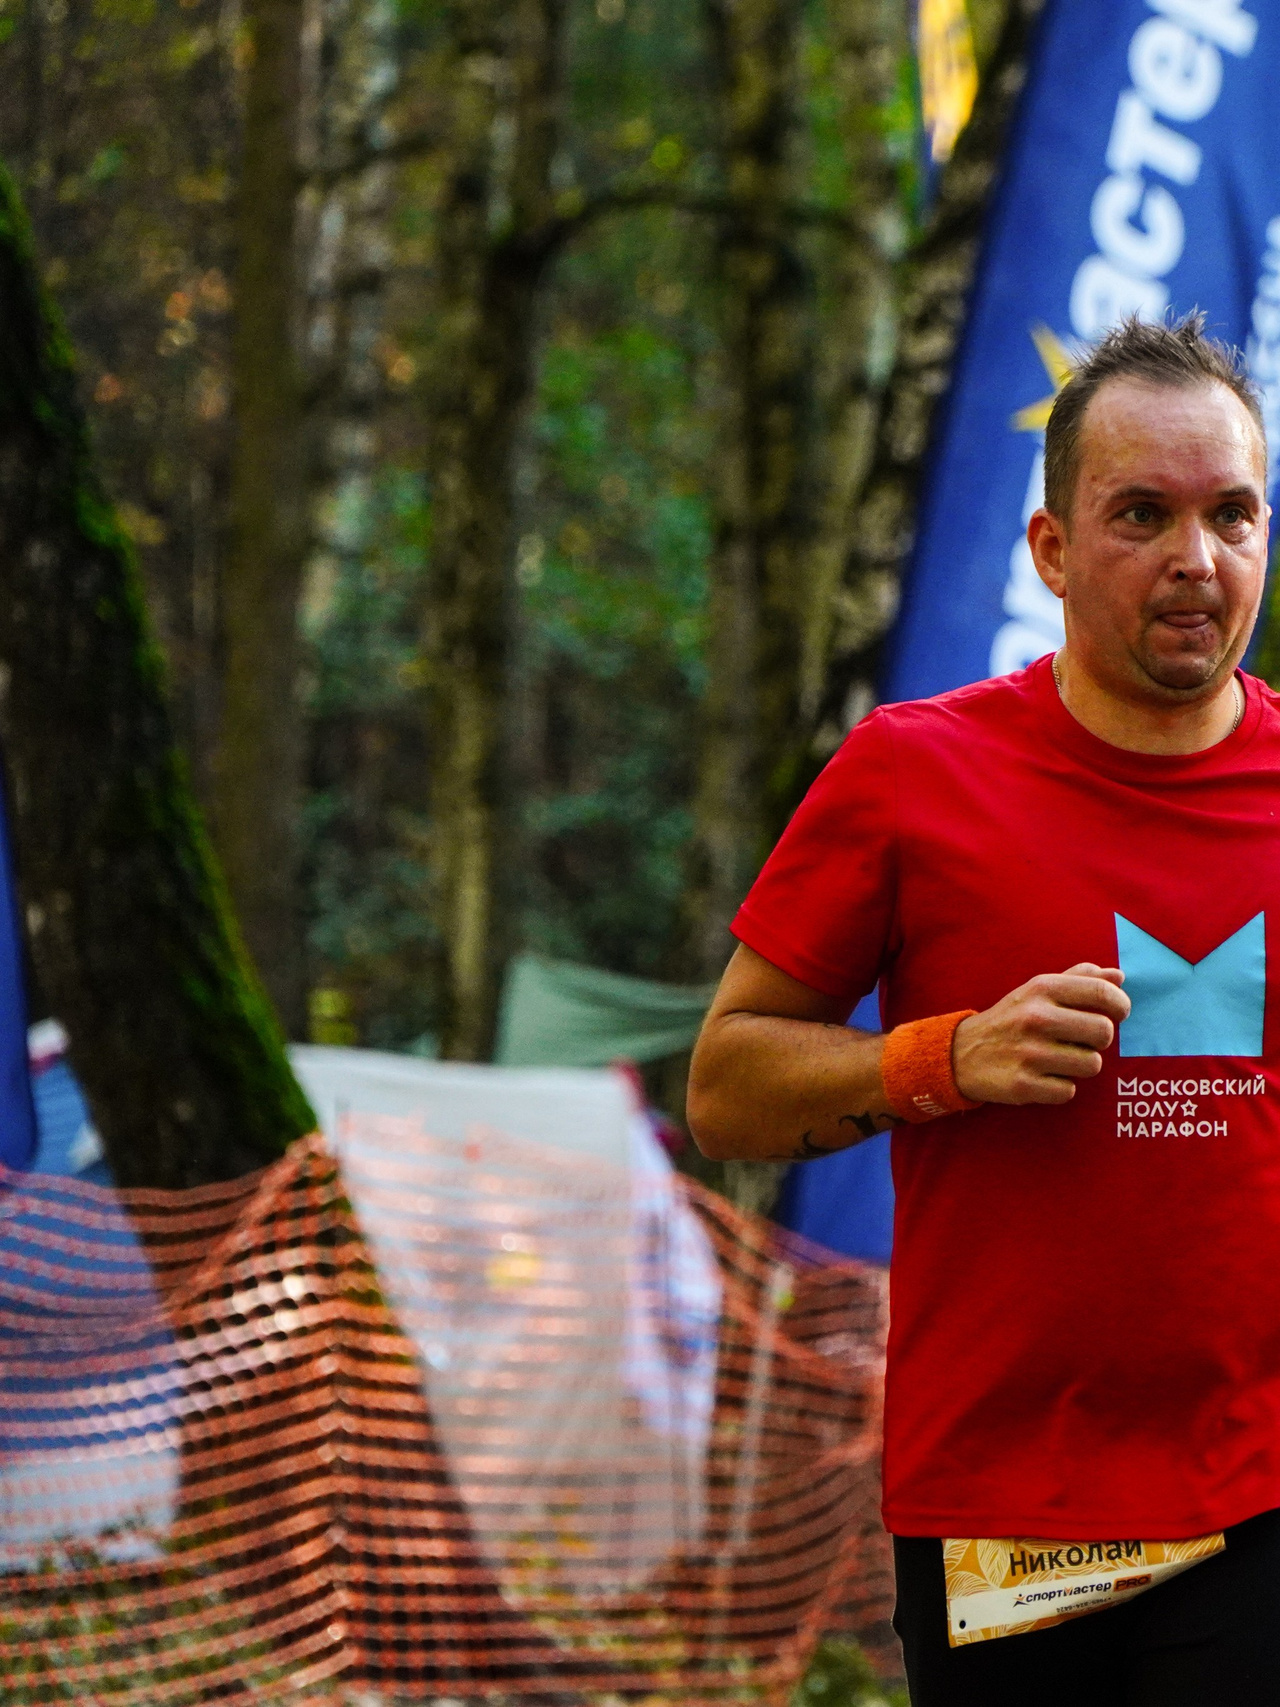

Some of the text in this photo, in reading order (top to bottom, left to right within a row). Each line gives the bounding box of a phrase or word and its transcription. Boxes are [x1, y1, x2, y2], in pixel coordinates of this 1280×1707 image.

[1117, 1101, 1179, 1117] ПОЛУ
[1117, 1120, 1229, 1138] МАРАФОН
[1115, 1575, 1151, 1591] PRO
